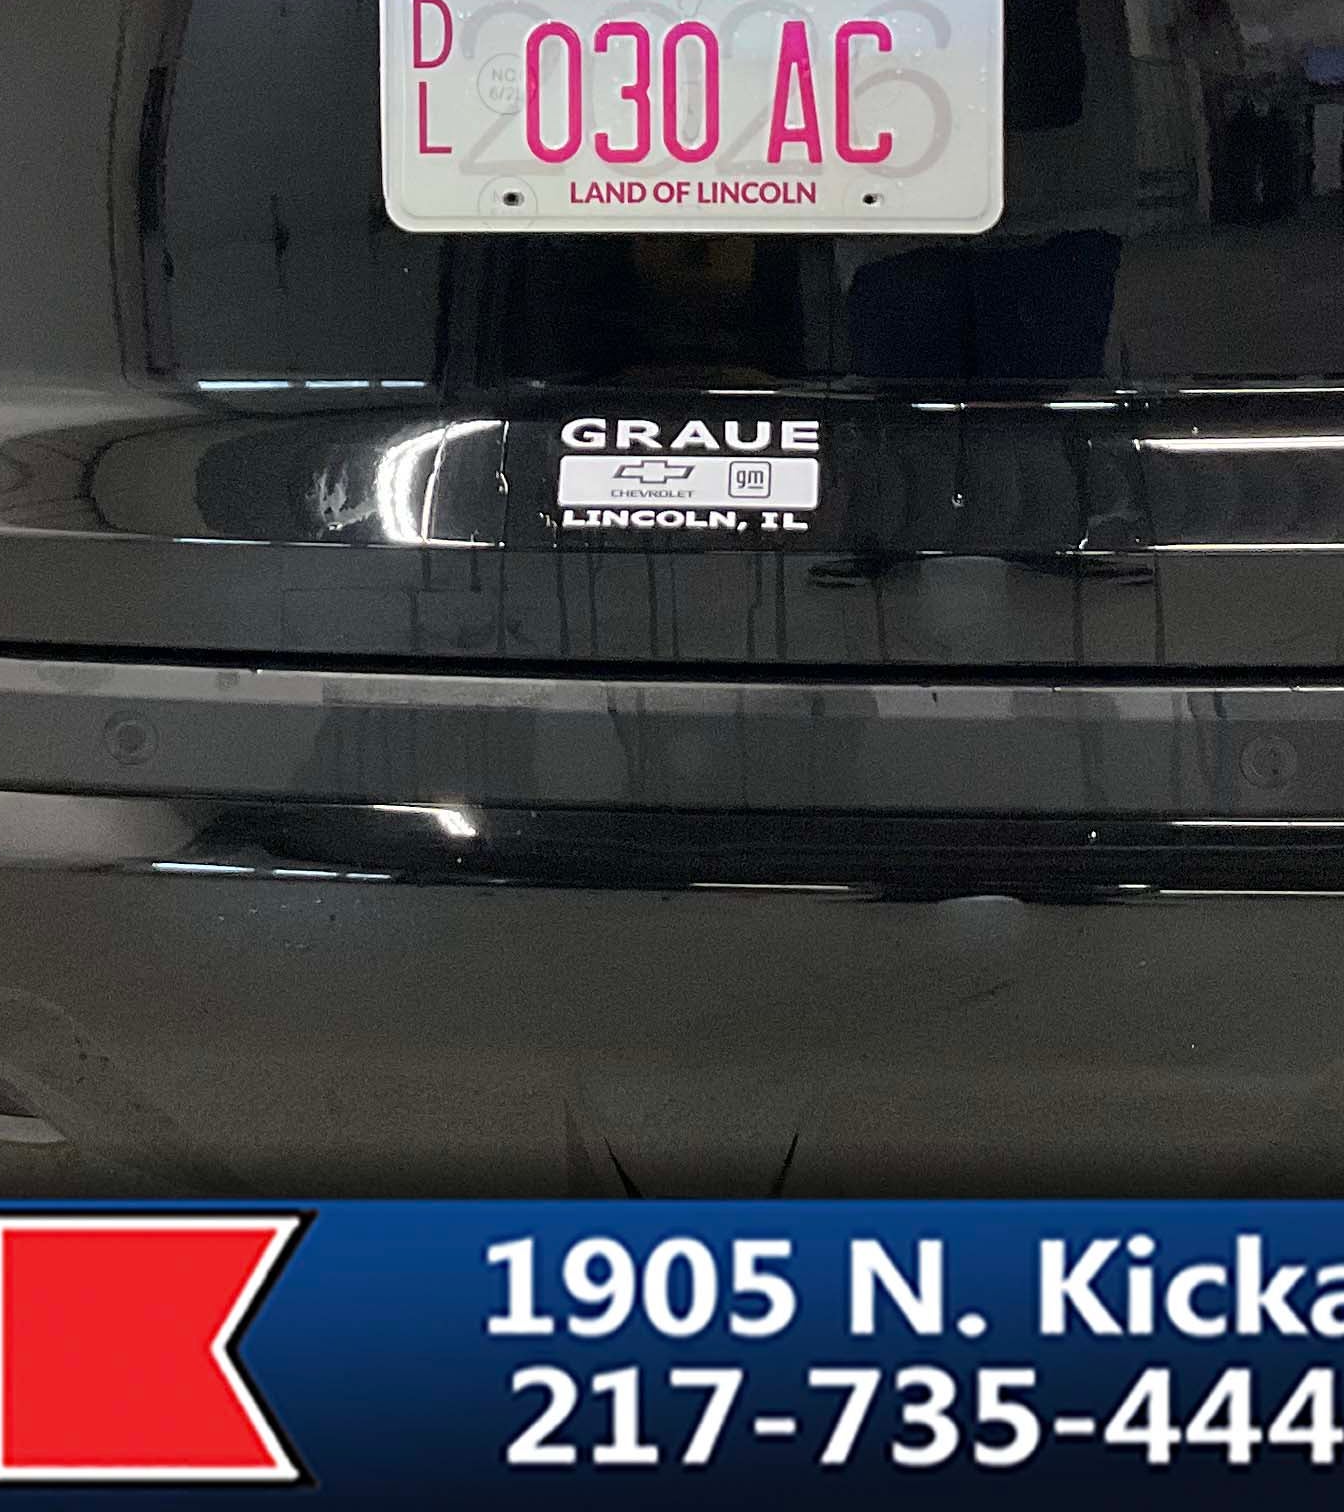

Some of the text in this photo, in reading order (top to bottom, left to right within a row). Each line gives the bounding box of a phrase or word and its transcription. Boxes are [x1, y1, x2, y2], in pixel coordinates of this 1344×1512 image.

[524, 19, 894, 166] 030 AC
[569, 180, 818, 205] LAND OF LINCOLN
[560, 417, 820, 451] GRAUE
[736, 469, 765, 490] gm
[611, 489, 695, 498] CHEVROLET
[561, 509, 809, 532] LINCOLN, IL
